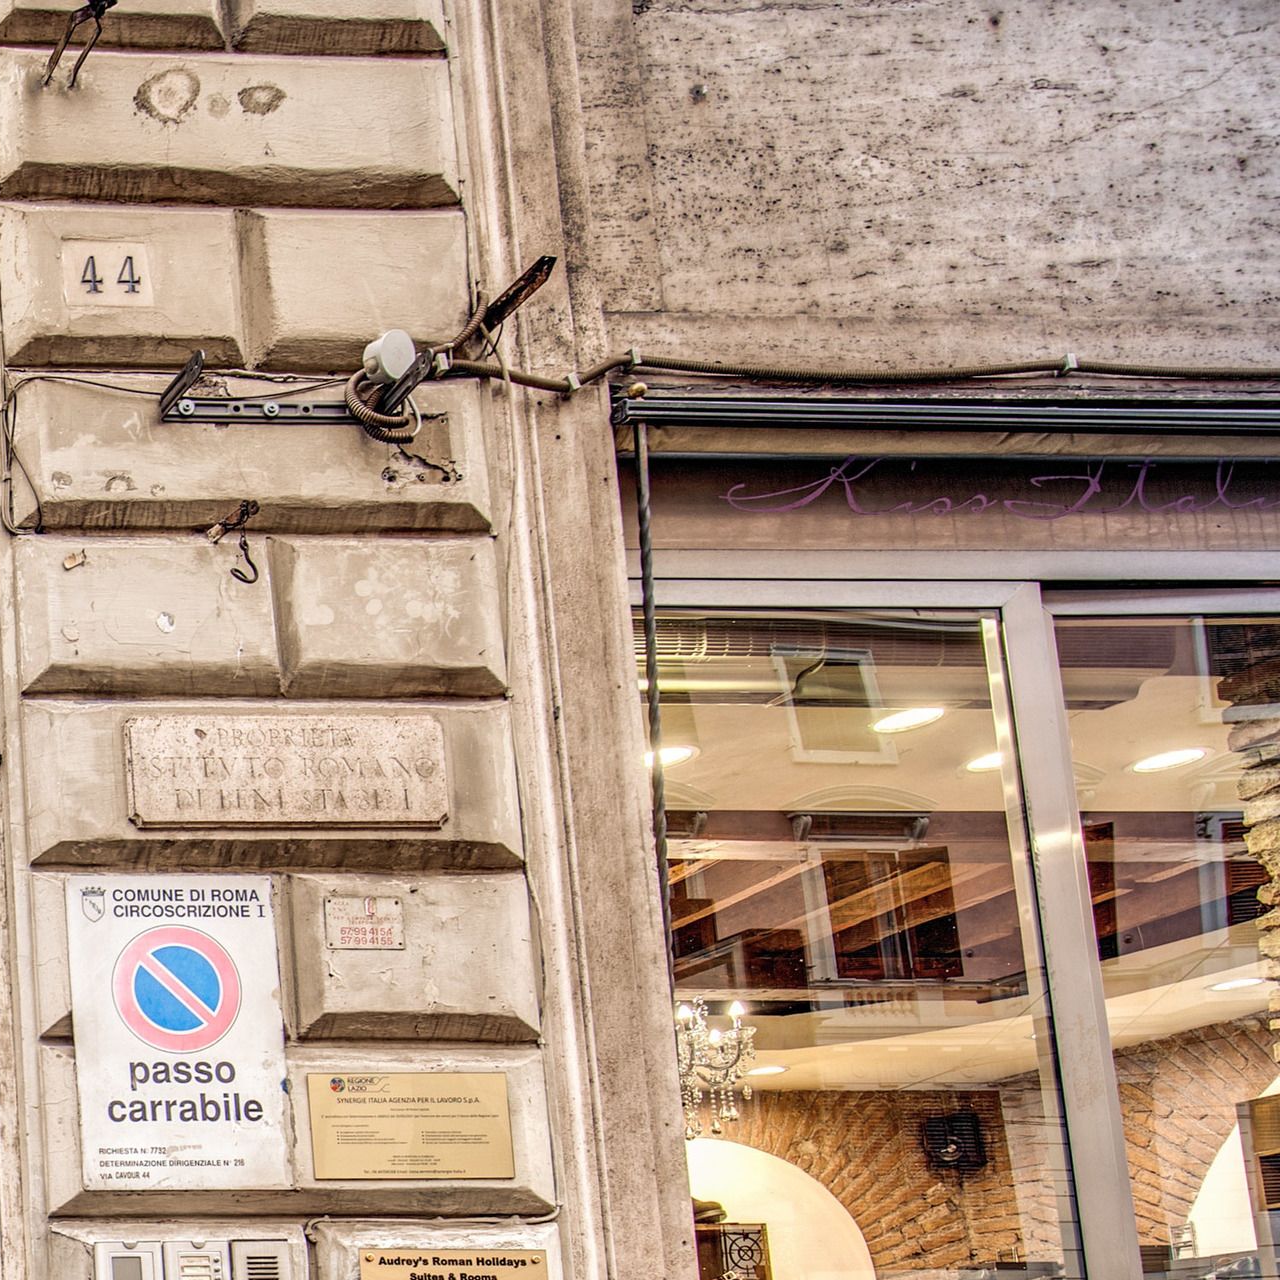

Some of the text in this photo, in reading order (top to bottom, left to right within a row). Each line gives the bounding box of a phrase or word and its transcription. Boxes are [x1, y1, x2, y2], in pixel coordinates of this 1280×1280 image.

[80, 255, 141, 294] 44
[302, 757, 435, 779] ROMANO
[175, 789, 203, 810] DI
[112, 889, 260, 902] COMUNE DI ROMA
[113, 904, 266, 918] CIRCOSCRIZIONE I
[129, 1060, 236, 1091] passo
[107, 1093, 264, 1122] carrabile
[98, 1147, 139, 1155] RICHIESTA
[99, 1160, 168, 1168] DETERMINAZIONE
[168, 1159, 222, 1167] DIRIGENZIALE
[115, 1171, 140, 1180] CAVOUR
[141, 1171, 150, 1179] 44
[378, 1256, 527, 1268] Audrey's Roman Holidays
